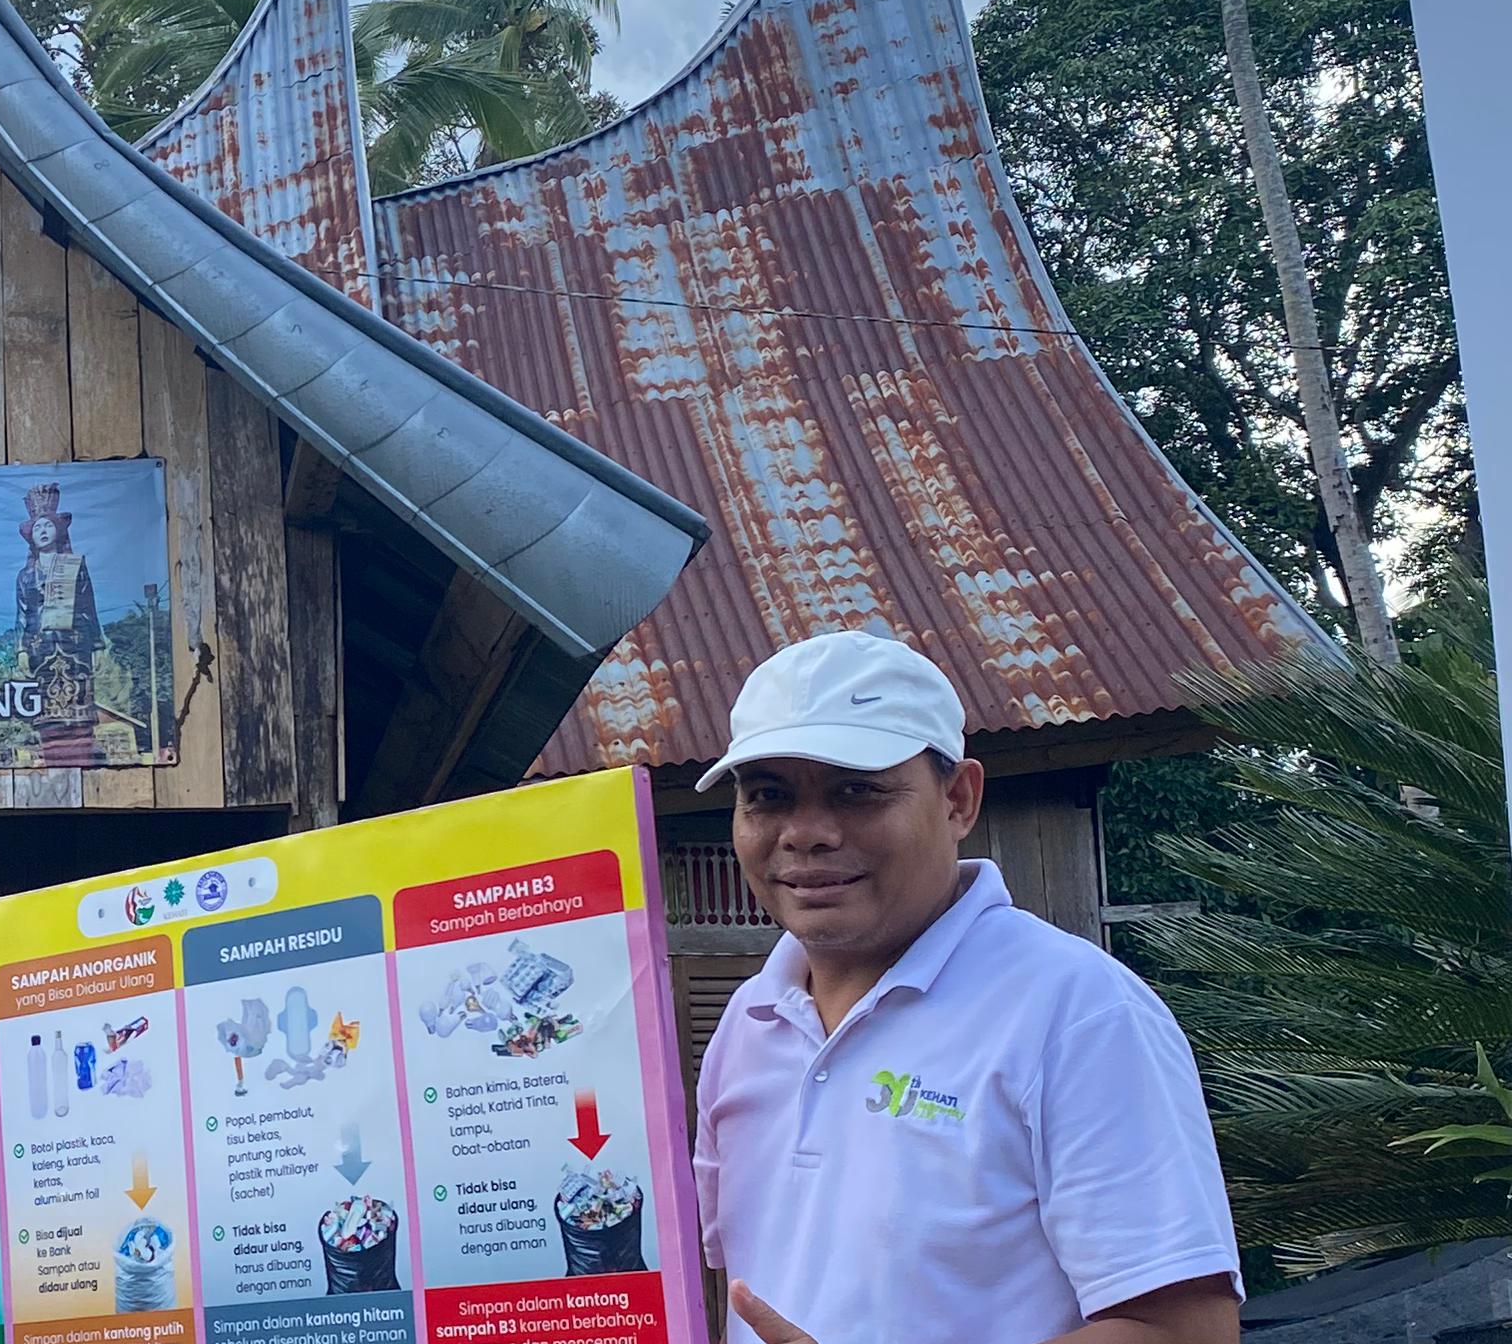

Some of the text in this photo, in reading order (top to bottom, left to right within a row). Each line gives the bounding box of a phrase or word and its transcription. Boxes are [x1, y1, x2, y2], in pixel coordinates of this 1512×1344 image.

[453, 875, 555, 909] SAMPAH B3
[430, 896, 583, 934] Sampah Berbahaya
[219, 926, 343, 964] SAMPAH RESIDU
[11, 949, 157, 990] SAMPAH ANORGANIK
[16, 972, 154, 1010] yang Bisa Didaur Ulang
[446, 1072, 569, 1099] Bahan kimia, Baterai,
[259, 1107, 314, 1124] pembalut,
[448, 1094, 558, 1119] Spidol, Katrid Tinta,
[227, 1130, 282, 1145] tisu bekas,
[450, 1123, 493, 1138] Lampu,
[31, 1141, 53, 1154] Botol
[228, 1146, 306, 1166] puntung rokok,
[452, 1138, 530, 1157] Obat-obatan
[32, 1154, 101, 1171] kaleng, kardus,
[229, 1162, 319, 1185] plastik multilayer
[230, 1183, 274, 1202] (sachet)
[456, 1179, 516, 1196] Tidak bisa
[458, 1200, 497, 1215] didaur
[232, 1222, 286, 1237] Tidak bisa
[460, 1218, 546, 1235] harus dibuang
[233, 1242, 268, 1256] didaur
[461, 1237, 547, 1256] dengan aman
[235, 1258, 312, 1274] harus dibuang
[236, 1278, 311, 1295] dengan aman
[459, 1292, 629, 1317] Simpan dalam kantong
[214, 1307, 404, 1335] Simpan dalam kantong hitam
[436, 1311, 657, 1340] sampah B3 karena berbahaya,
[66, 1329, 101, 1343] dalam
[104, 1325, 152, 1341] kantong
[154, 1321, 184, 1337] putih
[341, 1330, 356, 1343] ke
[359, 1328, 407, 1343] Paman
